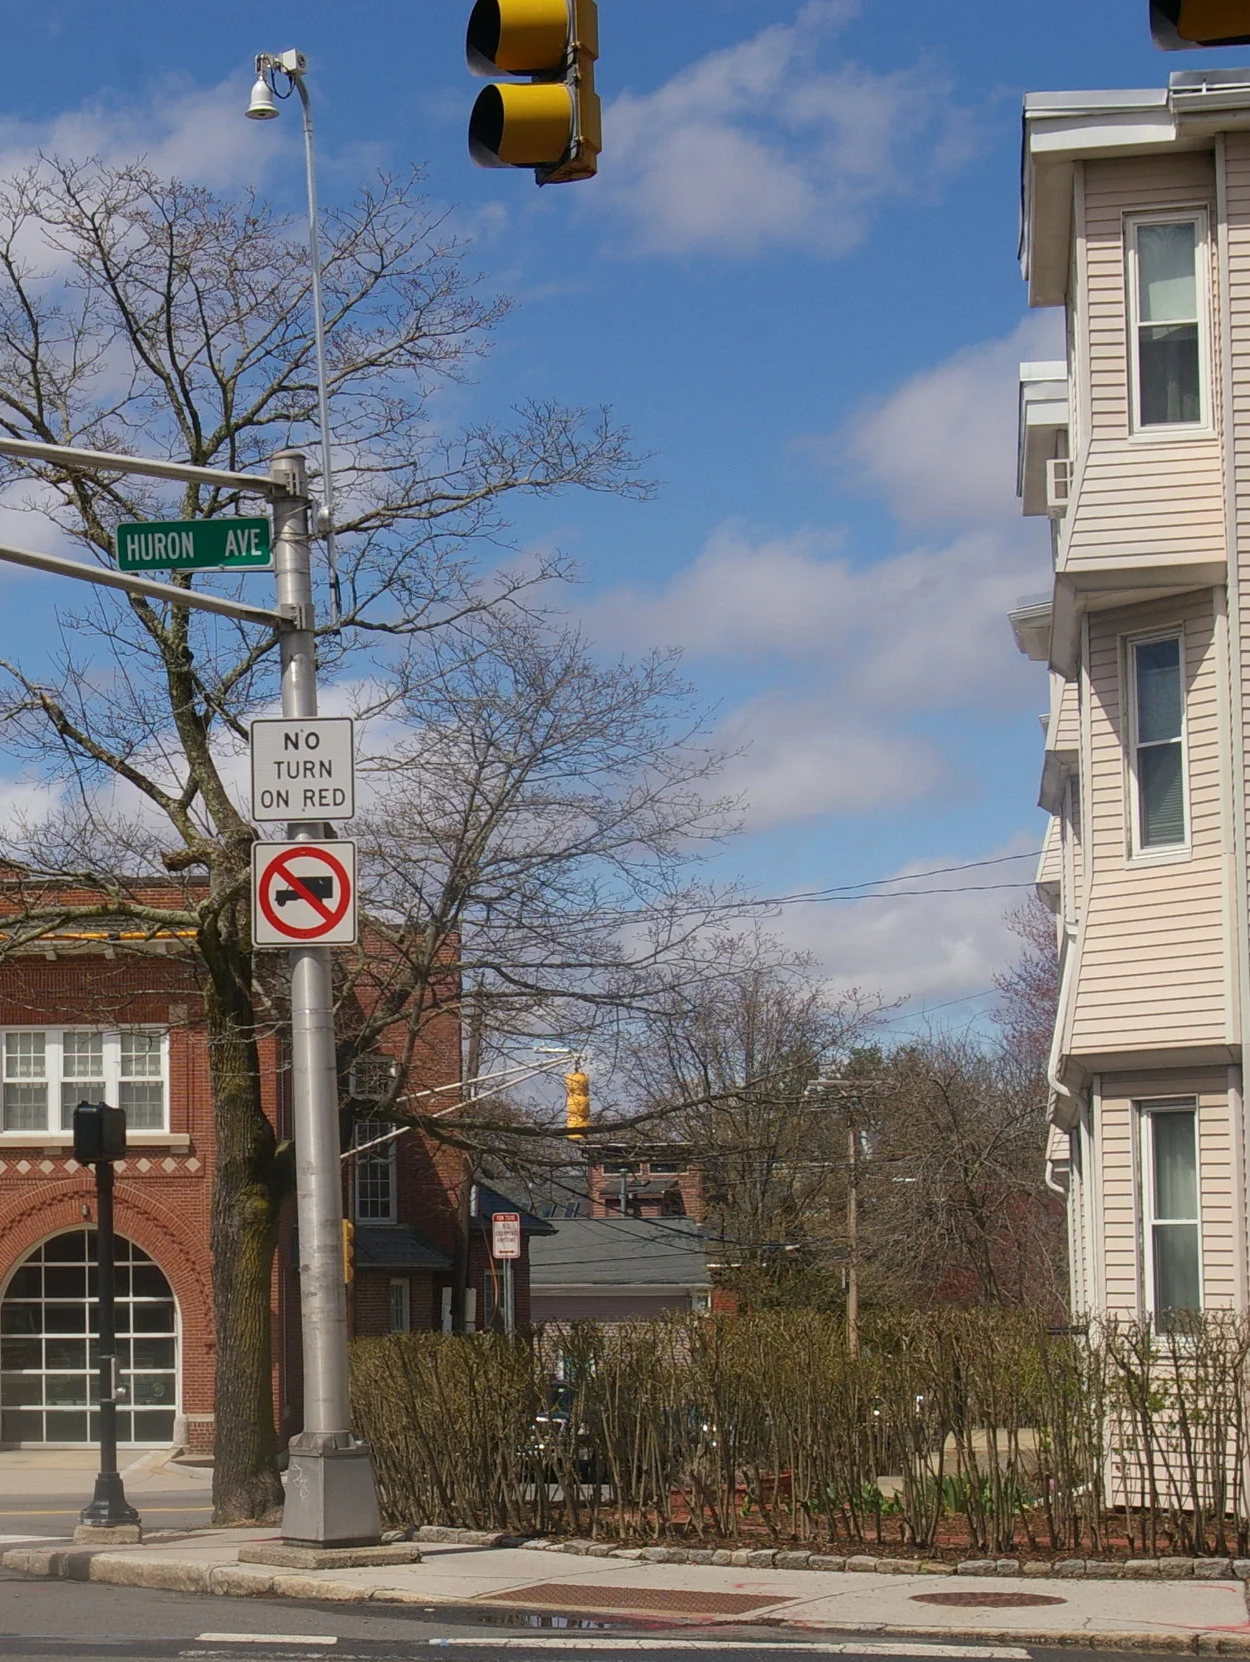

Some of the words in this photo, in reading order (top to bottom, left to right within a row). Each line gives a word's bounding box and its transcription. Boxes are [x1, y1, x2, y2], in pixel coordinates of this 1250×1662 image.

[126, 531, 195, 562] HURON
[224, 528, 262, 557] AVE
[284, 732, 320, 751] NO
[273, 760, 332, 779] TURN
[261, 789, 290, 808] ON
[303, 788, 346, 807] RED
